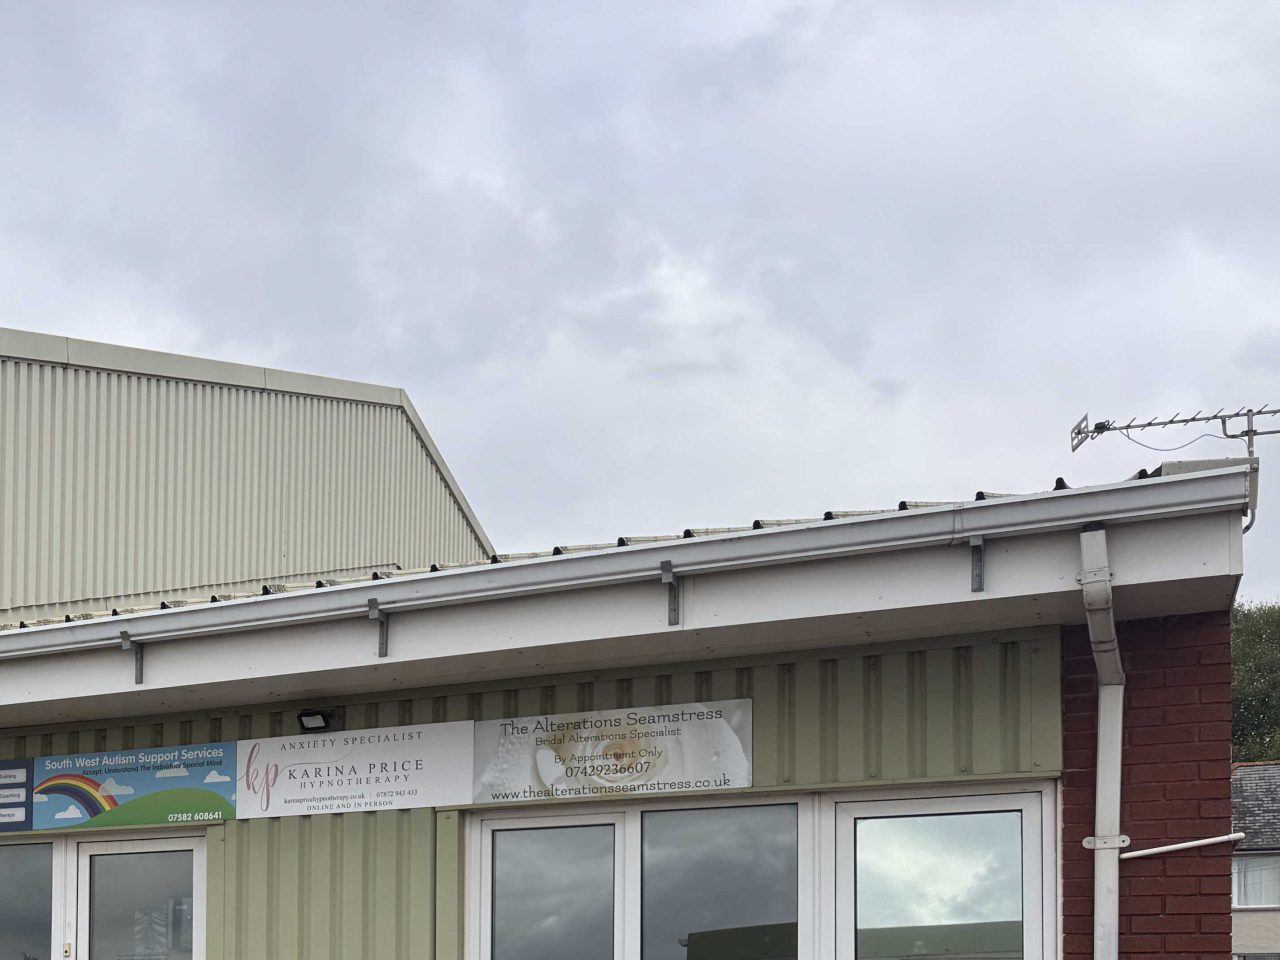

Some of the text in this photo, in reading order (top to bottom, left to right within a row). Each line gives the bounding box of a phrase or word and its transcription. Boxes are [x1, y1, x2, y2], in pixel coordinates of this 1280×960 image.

[500, 708, 723, 736] The Alterations Seamstress
[280, 731, 424, 752] ANXIETY SPECIALIST
[535, 726, 682, 747] Bridal Alterations Specialist
[45, 747, 224, 770] South West Autism Support Services
[104, 765, 139, 775] Understand
[140, 764, 151, 772] The
[183, 760, 205, 770] Special
[206, 759, 223, 767] Mind
[554, 748, 663, 765] By Appointment Only
[288, 759, 424, 780] KARINA PRICE
[565, 762, 651, 778] 07429236607
[300, 774, 411, 789] HYPNOTHERAPY
[491, 773, 731, 801] www.thealterationsseamstress.co.uk
[168, 811, 222, 822] 07582 608641
